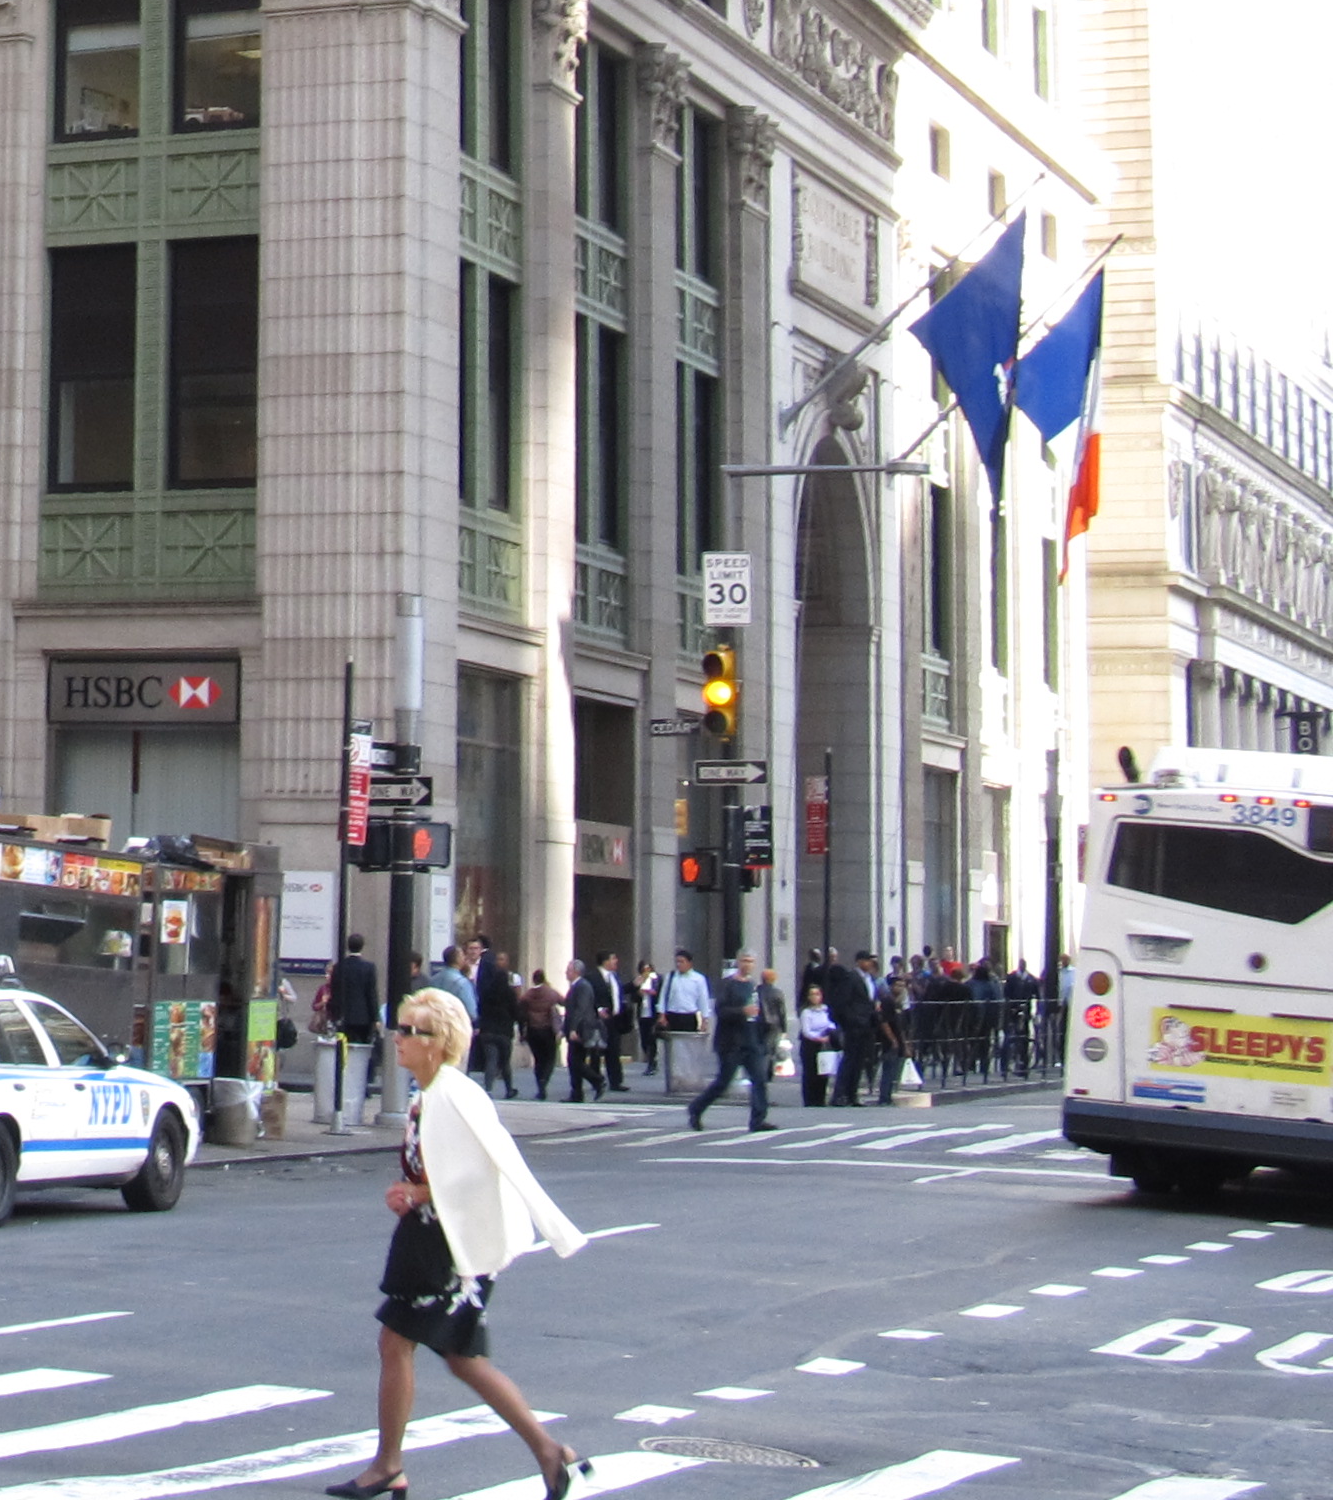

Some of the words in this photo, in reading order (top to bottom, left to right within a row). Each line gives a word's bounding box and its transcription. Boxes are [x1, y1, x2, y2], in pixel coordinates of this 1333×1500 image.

[706, 558, 749, 568] SPEED
[710, 571, 743, 580] LIMIT
[709, 583, 747, 605] 30
[63, 675, 163, 709] HSBC
[651, 722, 690, 734] CEDAR
[702, 768, 721, 778] ONE
[726, 768, 745, 778] WAY
[400, 786, 421, 798] WAY
[1232, 804, 1297, 827] 3849
[87, 1083, 132, 1125] NYPD
